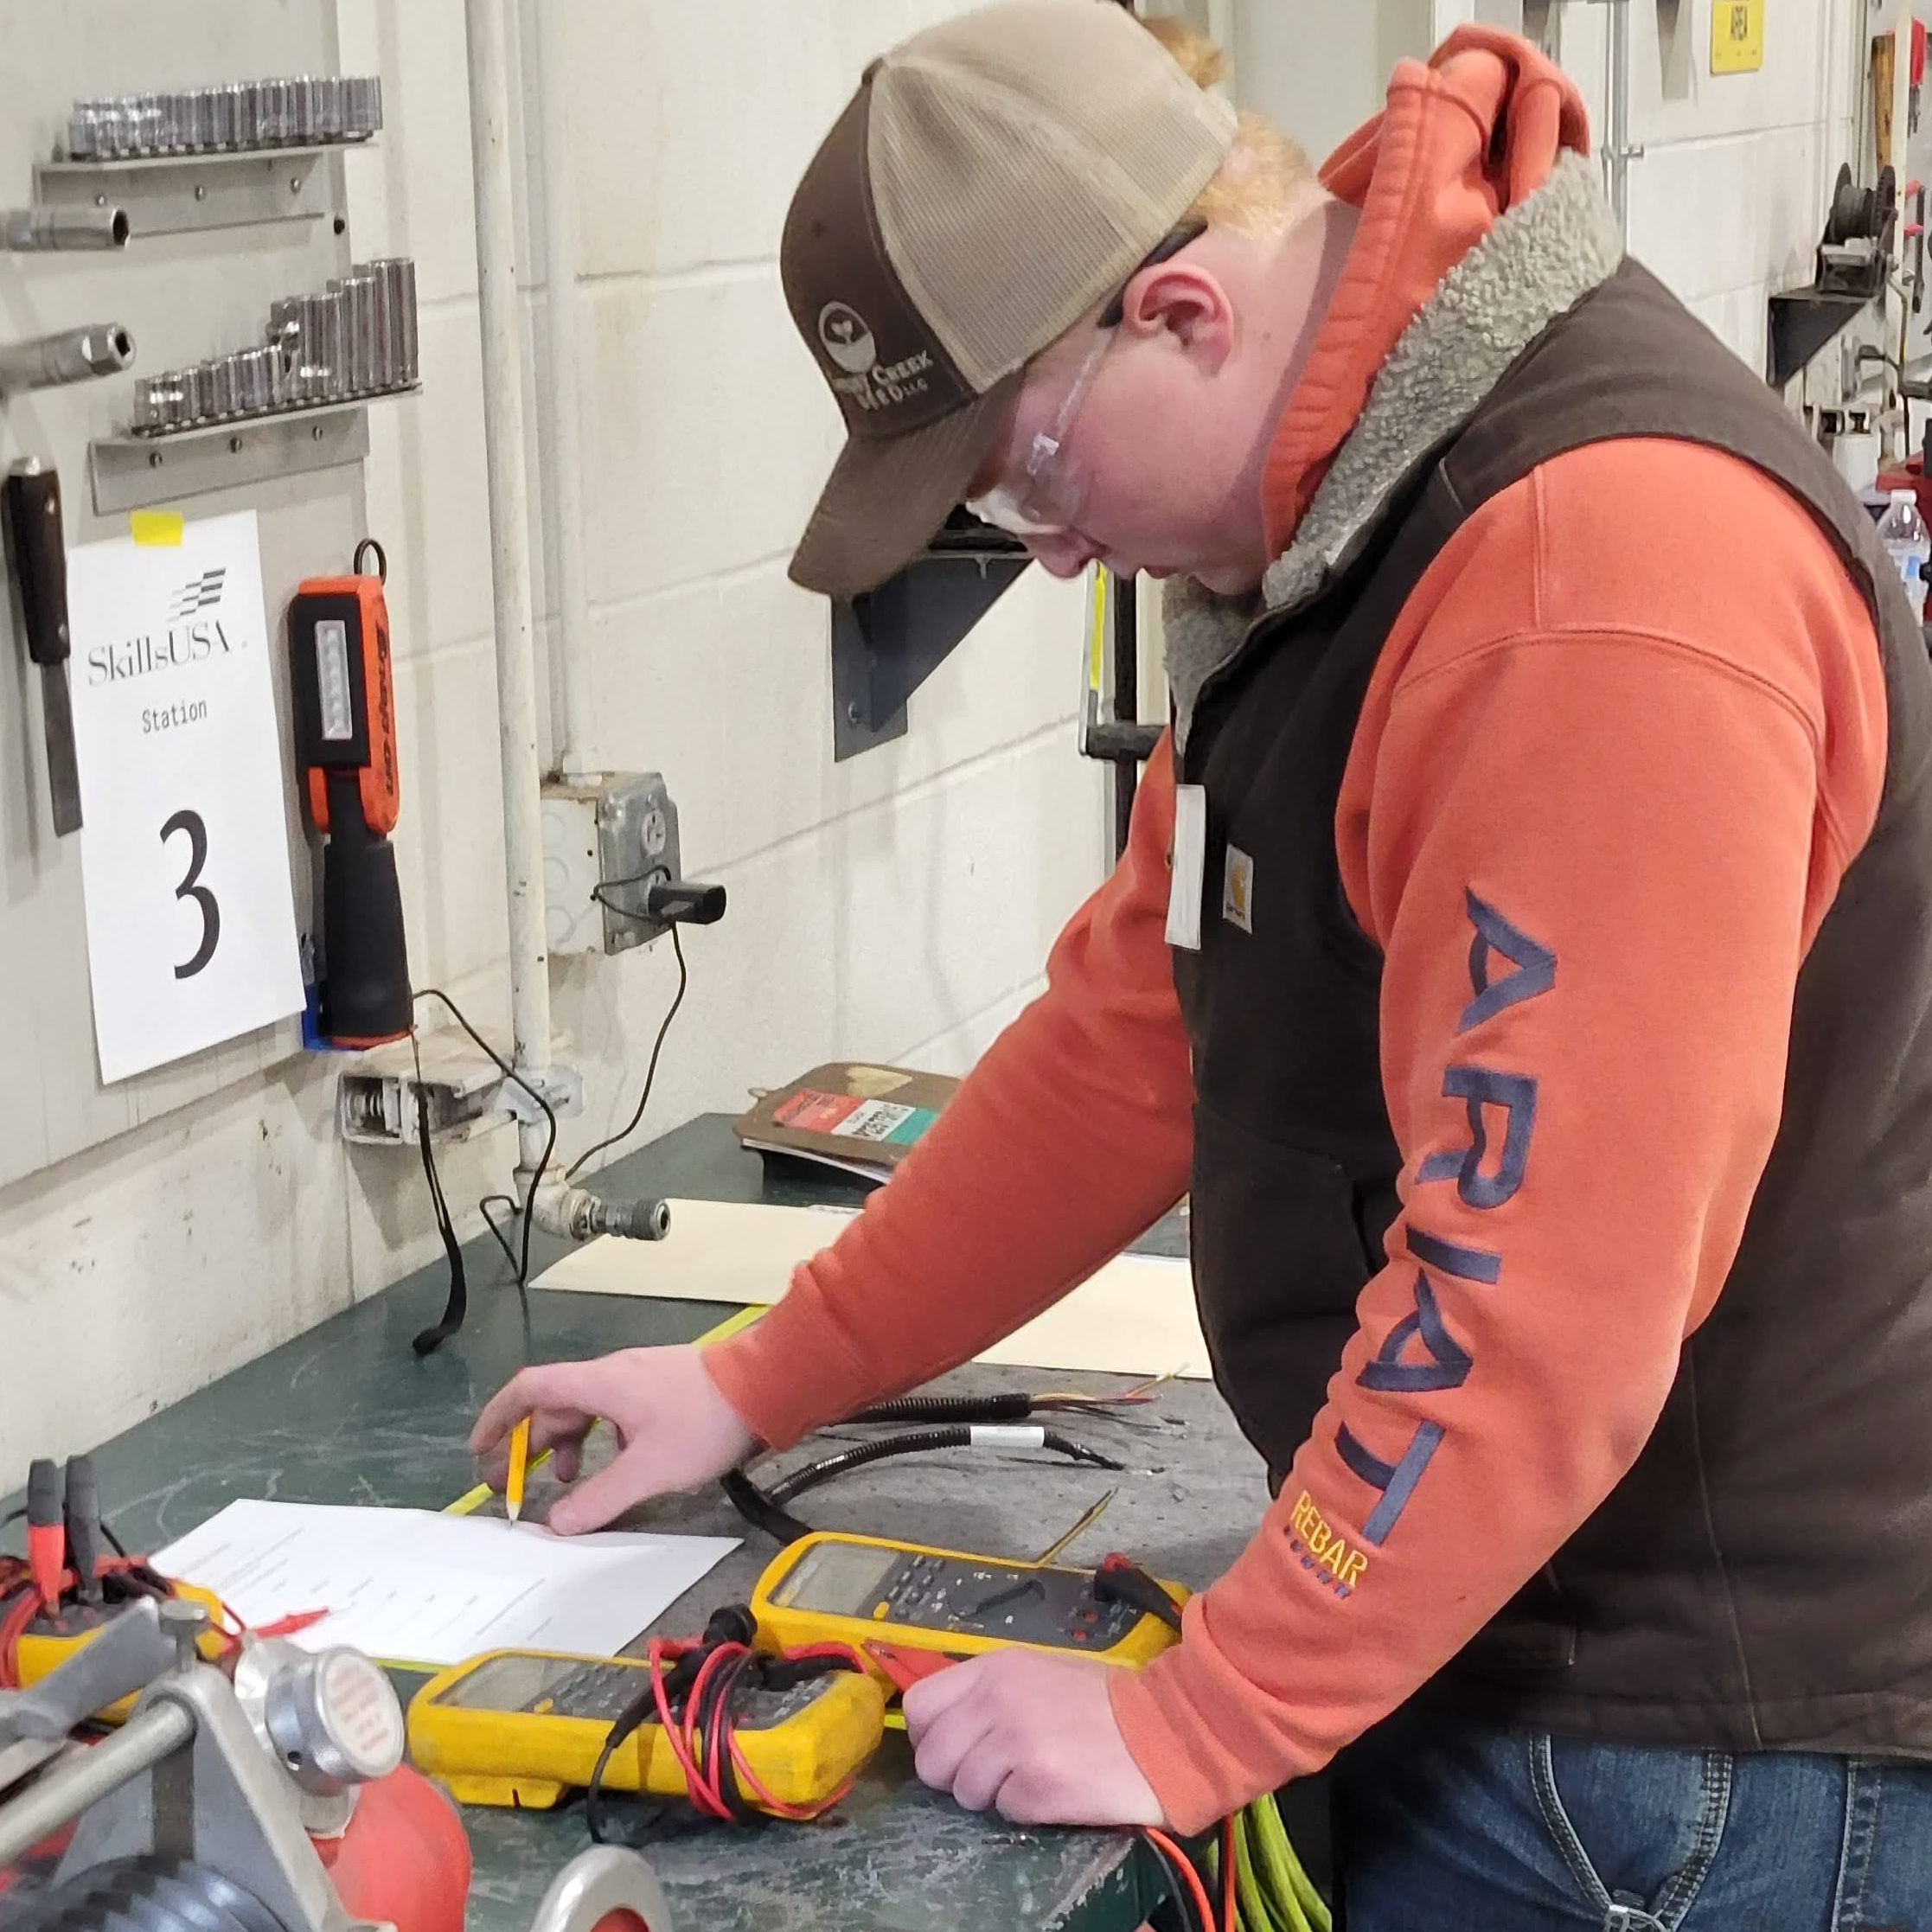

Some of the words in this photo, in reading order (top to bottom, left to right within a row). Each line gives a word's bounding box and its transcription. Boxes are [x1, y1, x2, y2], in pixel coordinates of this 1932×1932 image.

[88, 619, 233, 686] SkillsUSA
[142, 699, 208, 734] Station
[159, 809, 221, 980] 3
[1334, 884, 1560, 1547] ARIAT
[1289, 1489, 1369, 1589] REBAR
